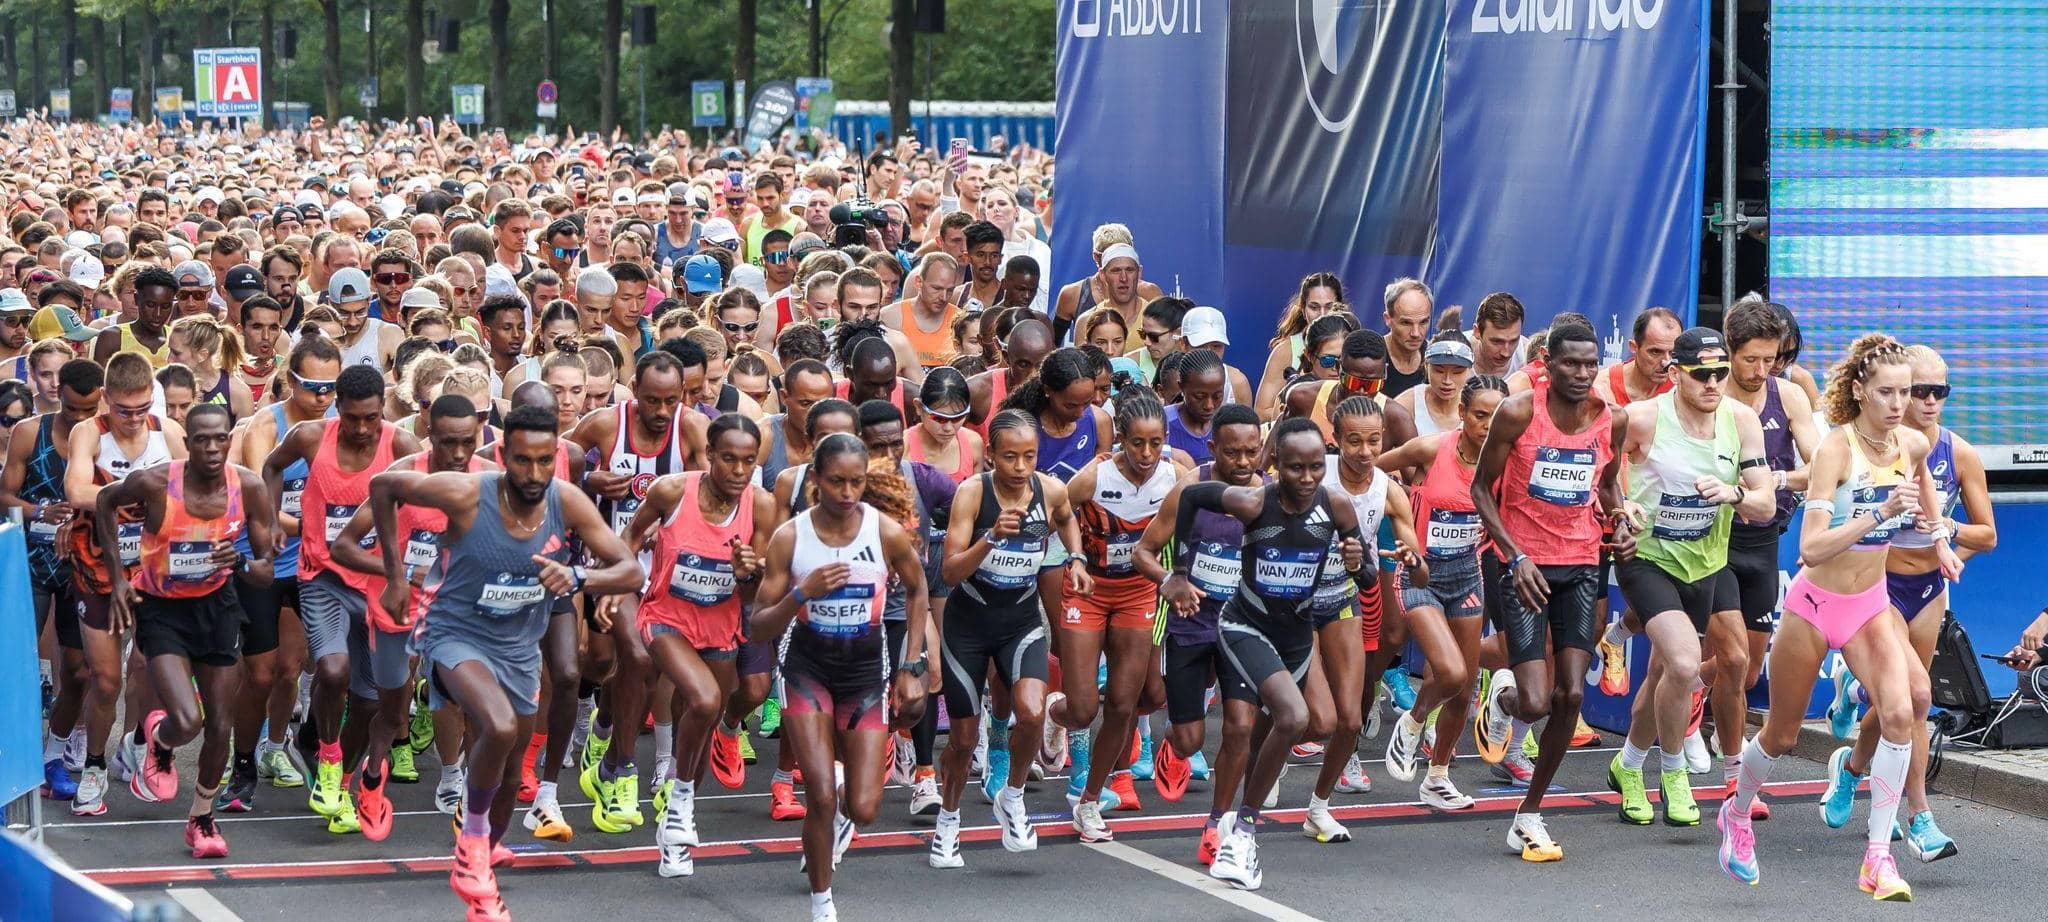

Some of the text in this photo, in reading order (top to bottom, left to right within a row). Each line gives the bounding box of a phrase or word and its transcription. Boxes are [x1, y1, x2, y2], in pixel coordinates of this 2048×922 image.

[216, 54, 256, 64] Startblock
[223, 66, 252, 100] A
[701, 92, 718, 116] B
[1541, 467, 1587, 481] ERENG
[1543, 489, 1577, 499] zalando
[1660, 510, 1715, 521] GRIFFITHS
[991, 554, 1033, 568] HIRPA
[680, 571, 733, 587] TARIKU
[486, 588, 542, 601] DUMECHA
